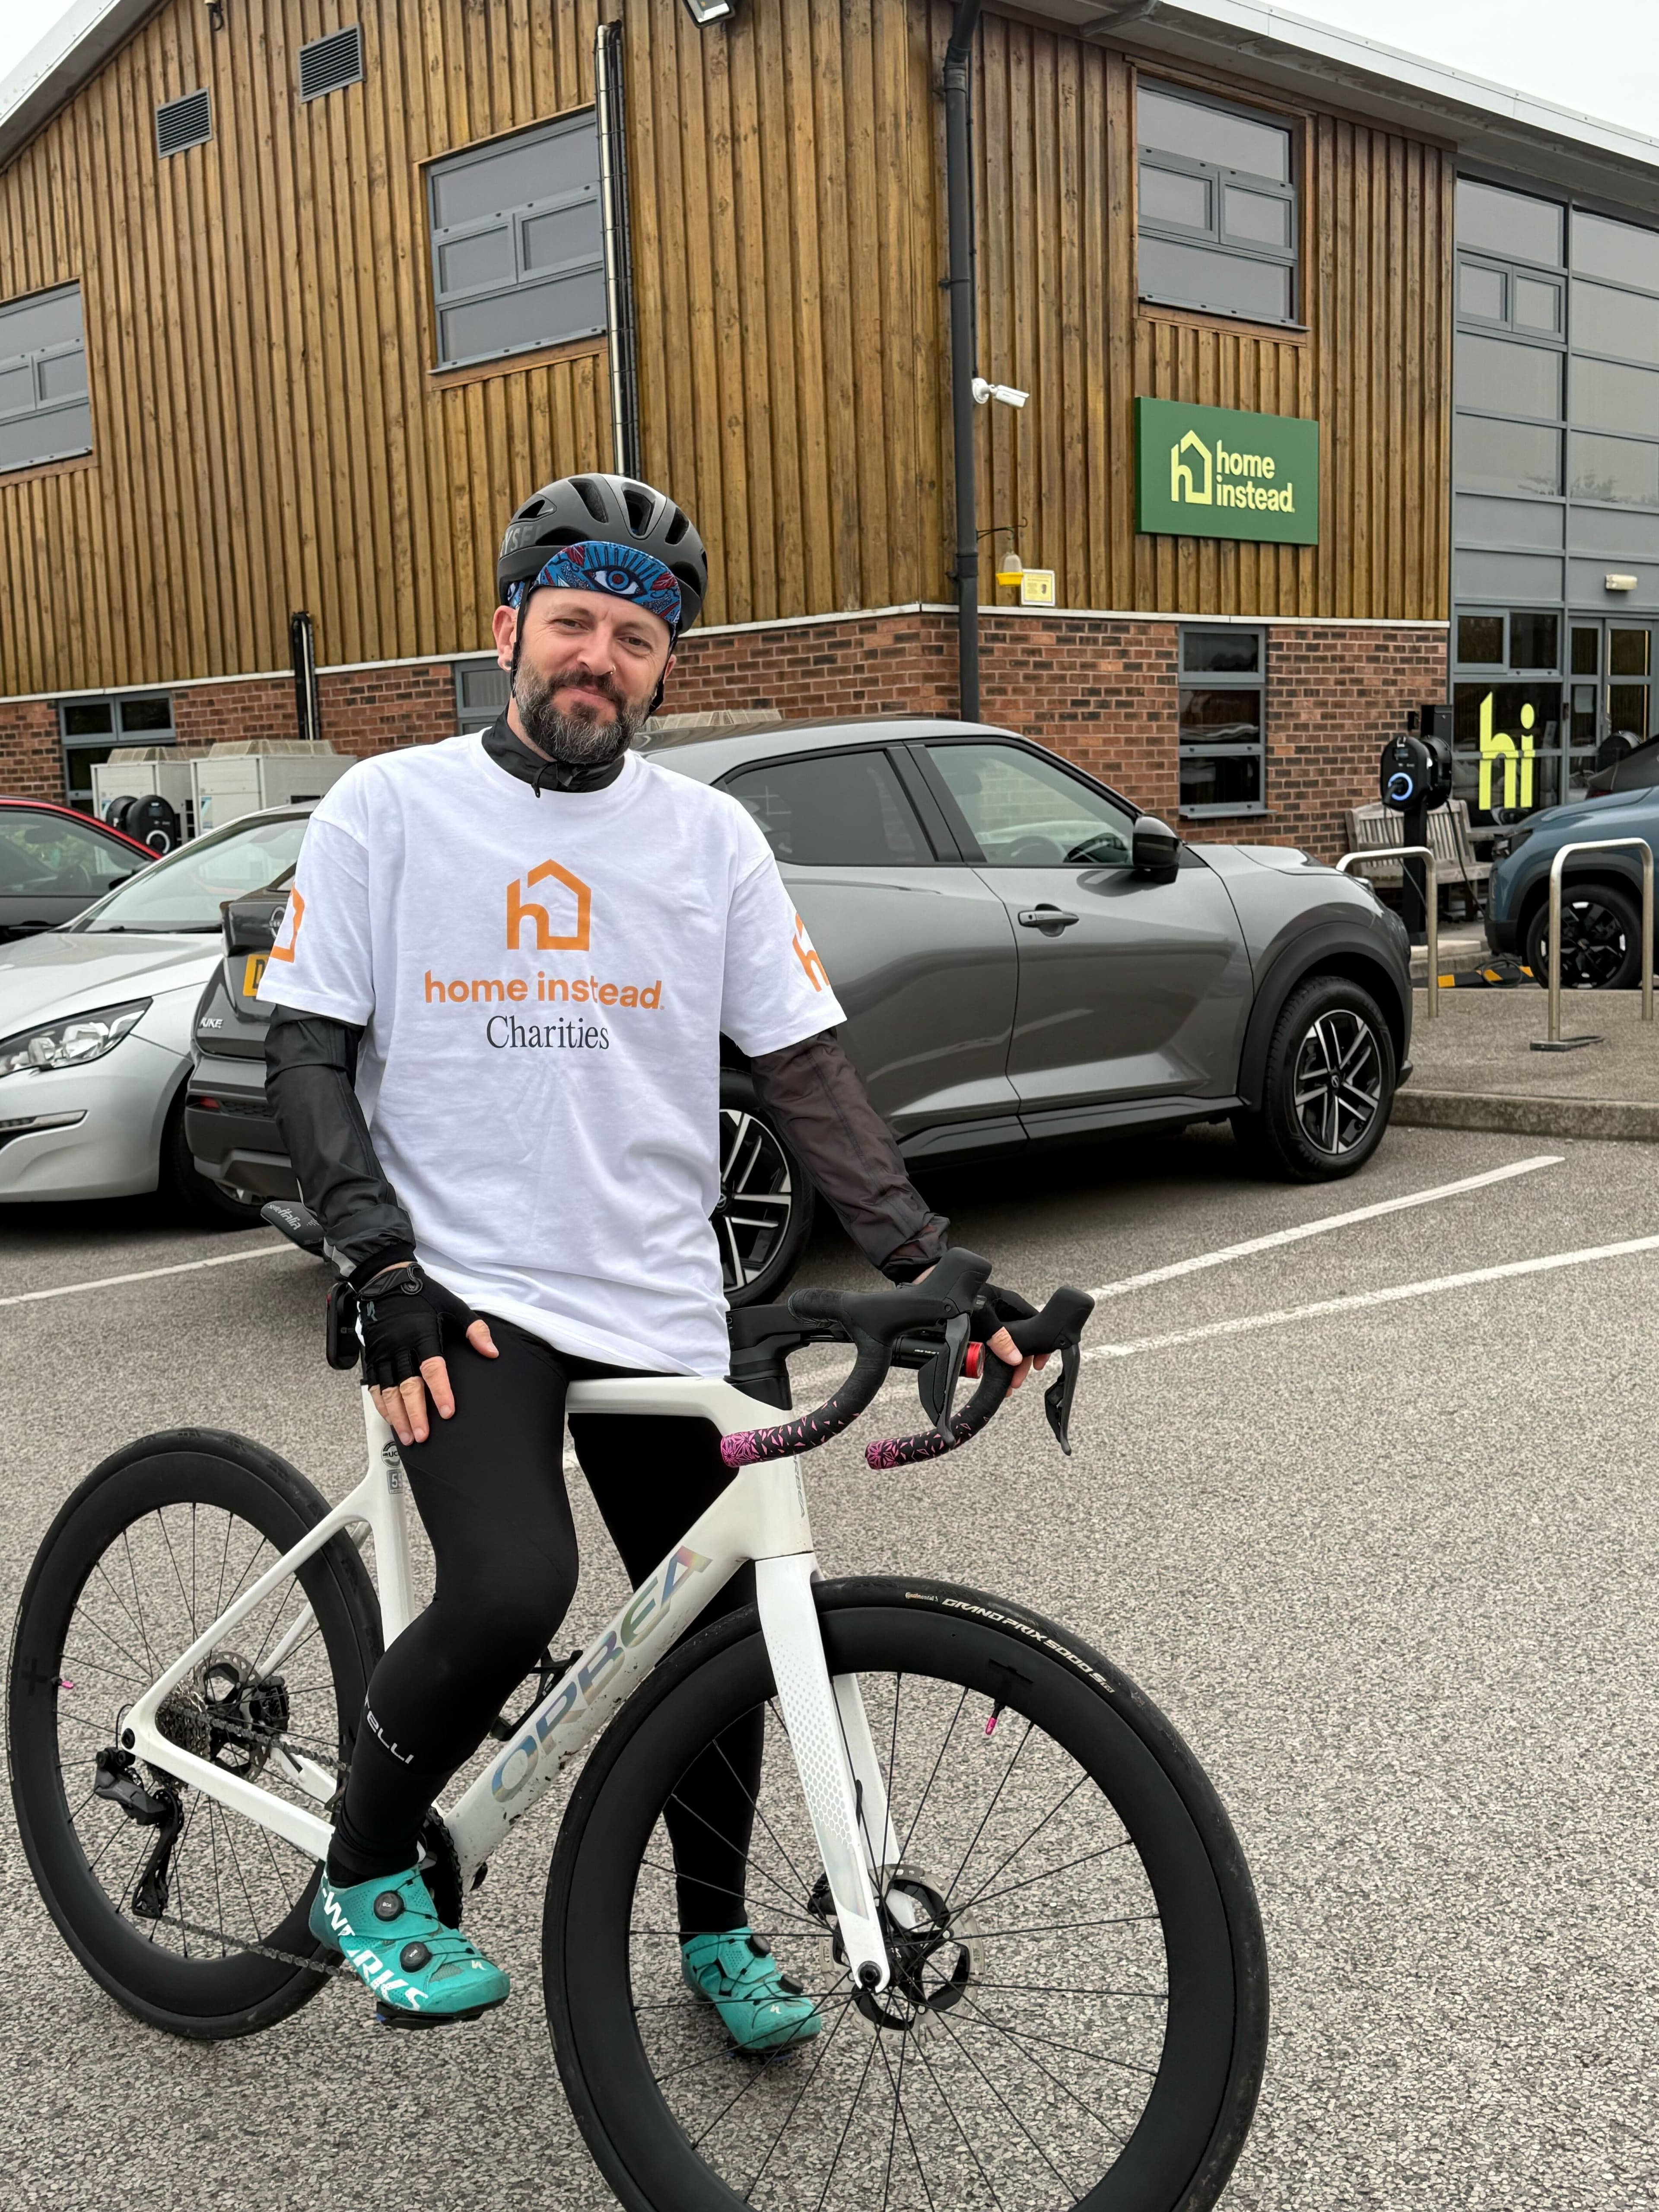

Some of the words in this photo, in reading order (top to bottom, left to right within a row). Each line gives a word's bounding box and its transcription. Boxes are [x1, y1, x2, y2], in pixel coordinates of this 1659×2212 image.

[1217, 439, 1275, 479] home
[1216, 476, 1295, 513] instead
[1479, 692, 1535, 810] hi
[424, 969, 528, 1003] home
[486, 1015, 610, 1050] Charities
[941, 1599, 1005, 1621] GRAND
[1002, 1618, 1047, 1642] PRIX
[1043, 1639, 1093, 1673] 5000
[492, 1545, 714, 1803] ORBEA
